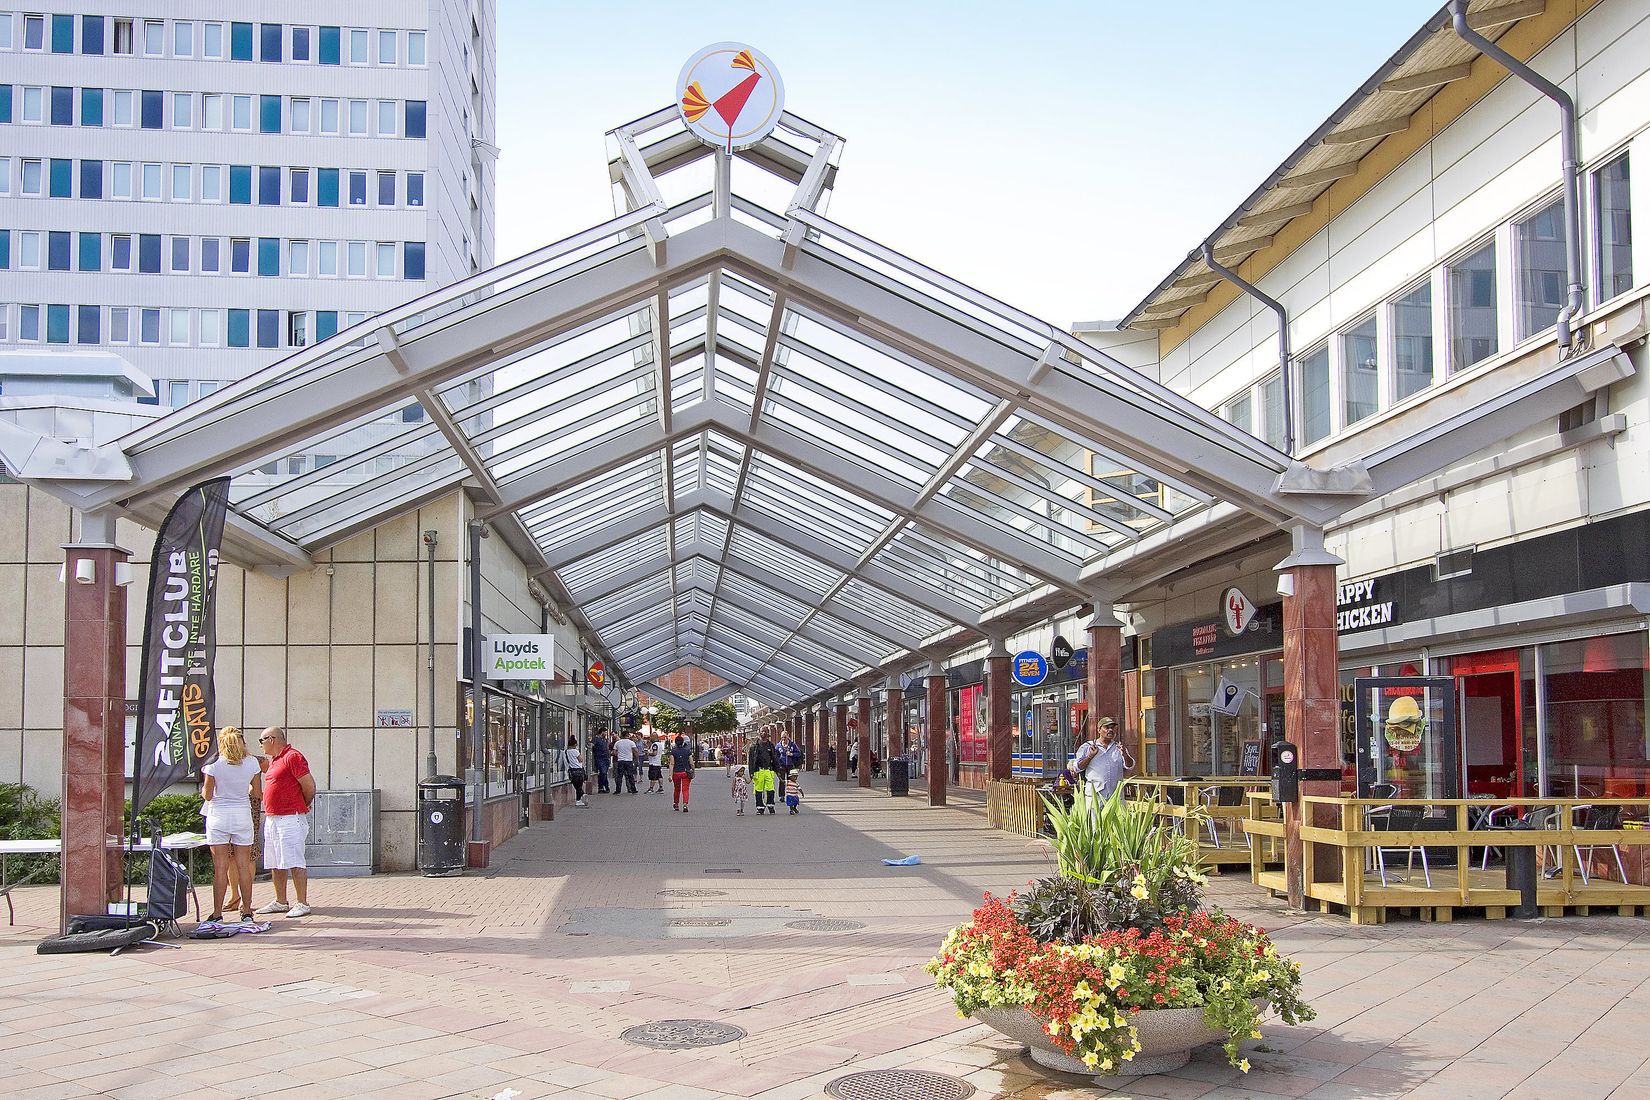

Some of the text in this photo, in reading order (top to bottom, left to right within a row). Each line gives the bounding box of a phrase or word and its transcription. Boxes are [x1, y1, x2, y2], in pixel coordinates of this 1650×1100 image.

[1337, 579, 1374, 606] APPY
[189, 615, 201, 644] INTE
[1337, 602, 1392, 631] HICKEN
[494, 640, 539, 656] Lloyds
[494, 656, 546, 672] Apotek
[1019, 662, 1039, 672] 24
[183, 683, 210, 758] GRATIS
